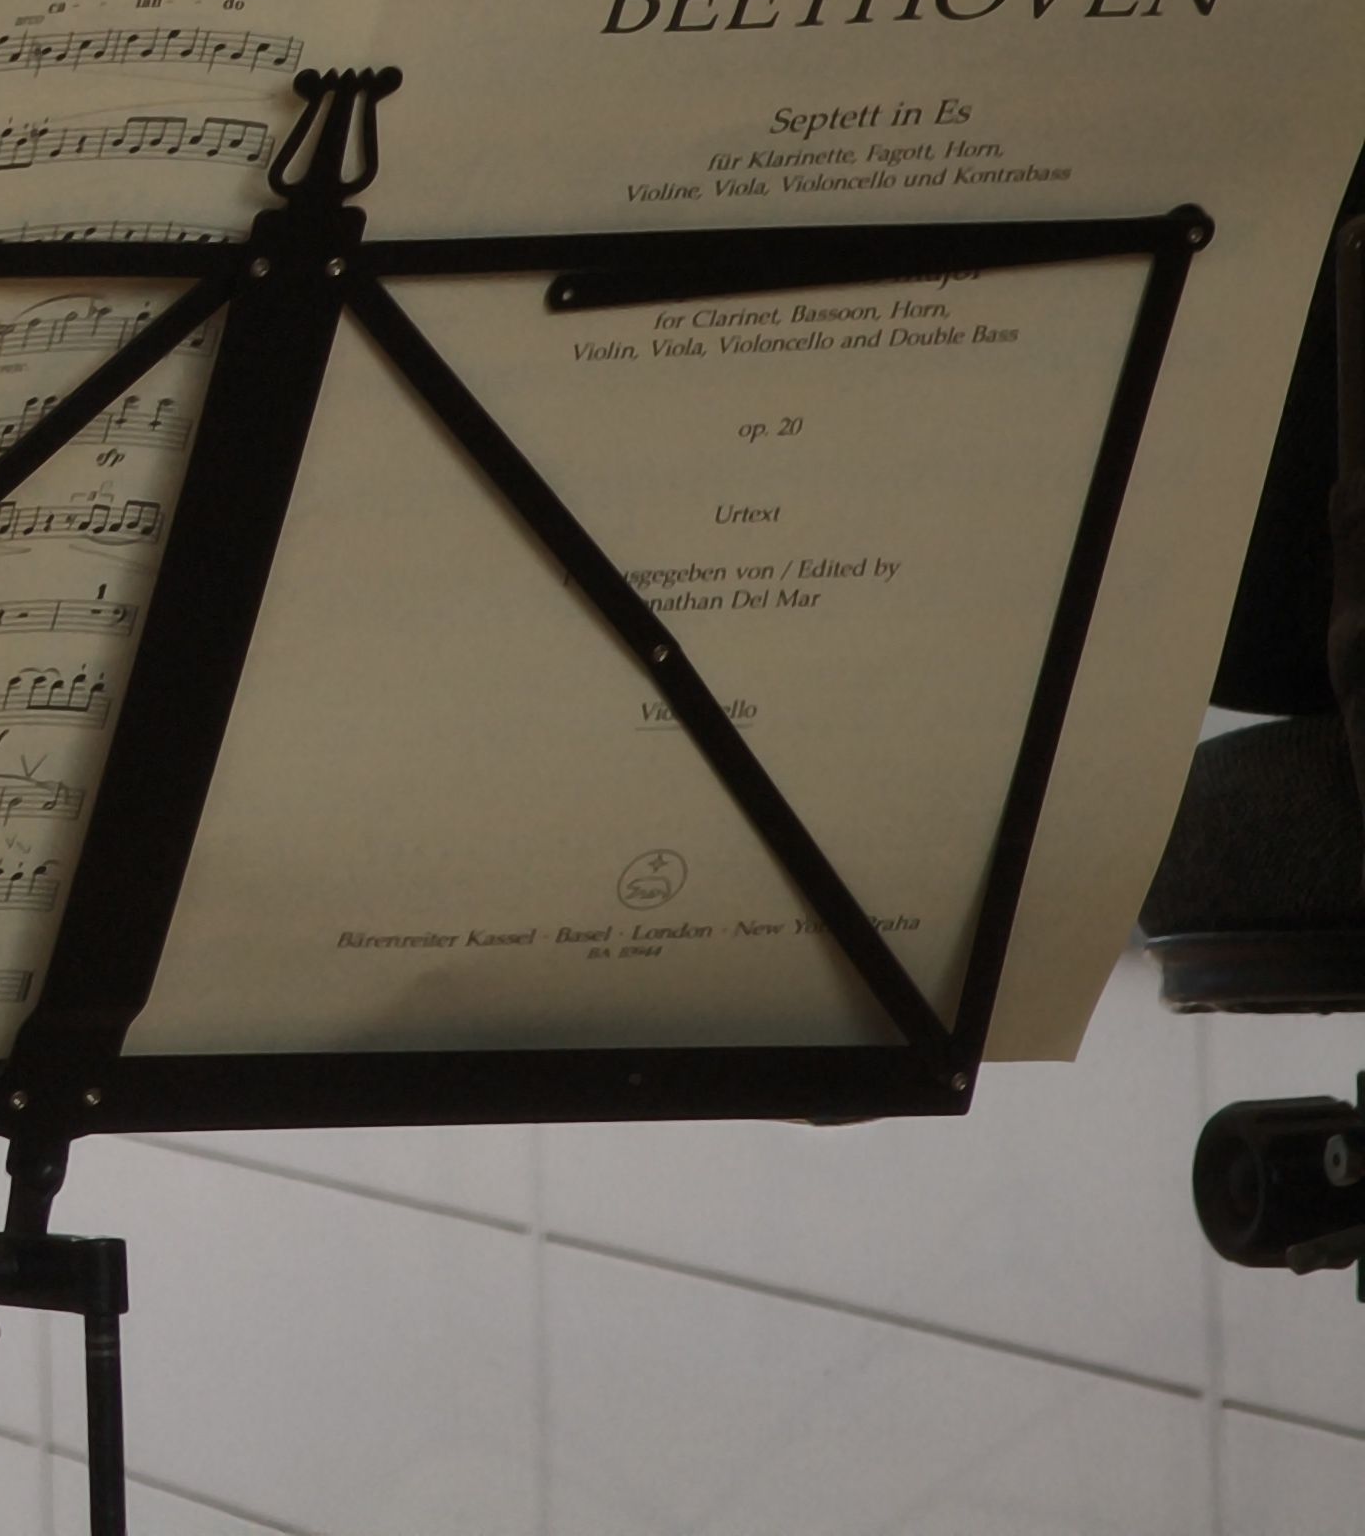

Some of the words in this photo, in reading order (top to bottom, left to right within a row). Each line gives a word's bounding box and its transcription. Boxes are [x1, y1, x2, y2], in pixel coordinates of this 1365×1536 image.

[769, 102, 883, 140] Septett
[892, 102, 923, 128] in
[935, 99, 973, 125] Es
[707, 151, 743, 173] für
[747, 146, 857, 171] Klarinette,
[865, 143, 936, 170] Fagott,
[944, 140, 1005, 162] Horn,
[626, 182, 703, 204] Violine,
[714, 178, 770, 200] Viola,
[781, 169, 897, 196] Violoncello
[903, 167, 947, 190] und
[953, 163, 1073, 186] Kontrabass
[653, 311, 686, 331] for
[691, 308, 783, 330] Clarinet,
[790, 304, 882, 325] Bassoon,
[890, 300, 952, 320] Horn,
[573, 341, 639, 363] Violin,
[651, 337, 708, 359] Viola,
[719, 331, 835, 356] Violoncello
[840, 328, 883, 350] and
[887, 326, 967, 348] Double
[971, 324, 1020, 344] Bass
[738, 421, 769, 444] op.
[776, 417, 805, 438] 20
[714, 504, 782, 526] Urtext
[736, 565, 775, 581] von
[779, 560, 795, 581] /
[797, 557, 867, 579] Edited
[874, 557, 902, 584] by
[731, 589, 769, 611] Del
[776, 588, 822, 609] Mar
[336, 928, 460, 951] Bärenreiter
[464, 927, 536, 948] Kassel
[555, 925, 612, 944] Basel
[631, 921, 714, 943] London
[734, 919, 786, 938] New
